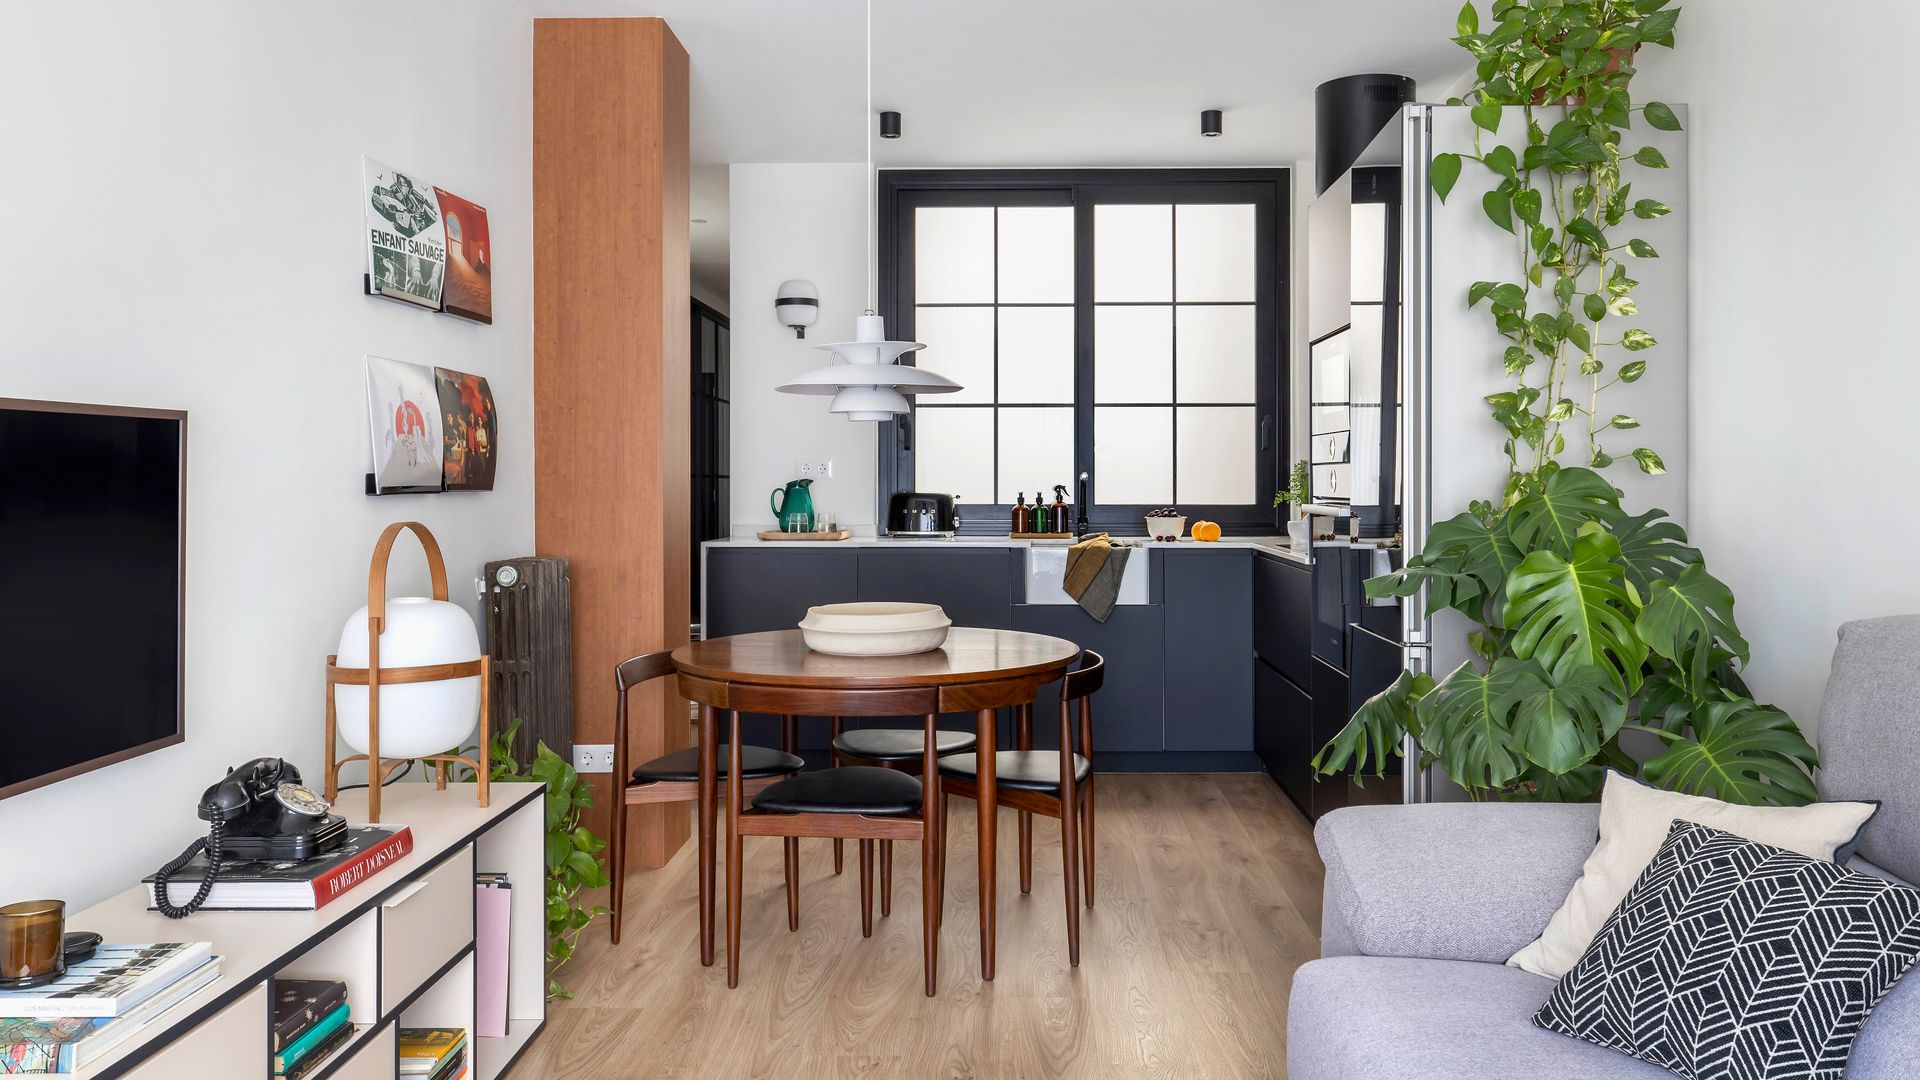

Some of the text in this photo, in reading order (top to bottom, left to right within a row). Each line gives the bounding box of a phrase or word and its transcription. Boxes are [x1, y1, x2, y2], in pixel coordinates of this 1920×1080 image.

[371, 228, 406, 252] ENFANT
[408, 239, 445, 263] SAUVAGE
[329, 861, 364, 895] ROBERT
